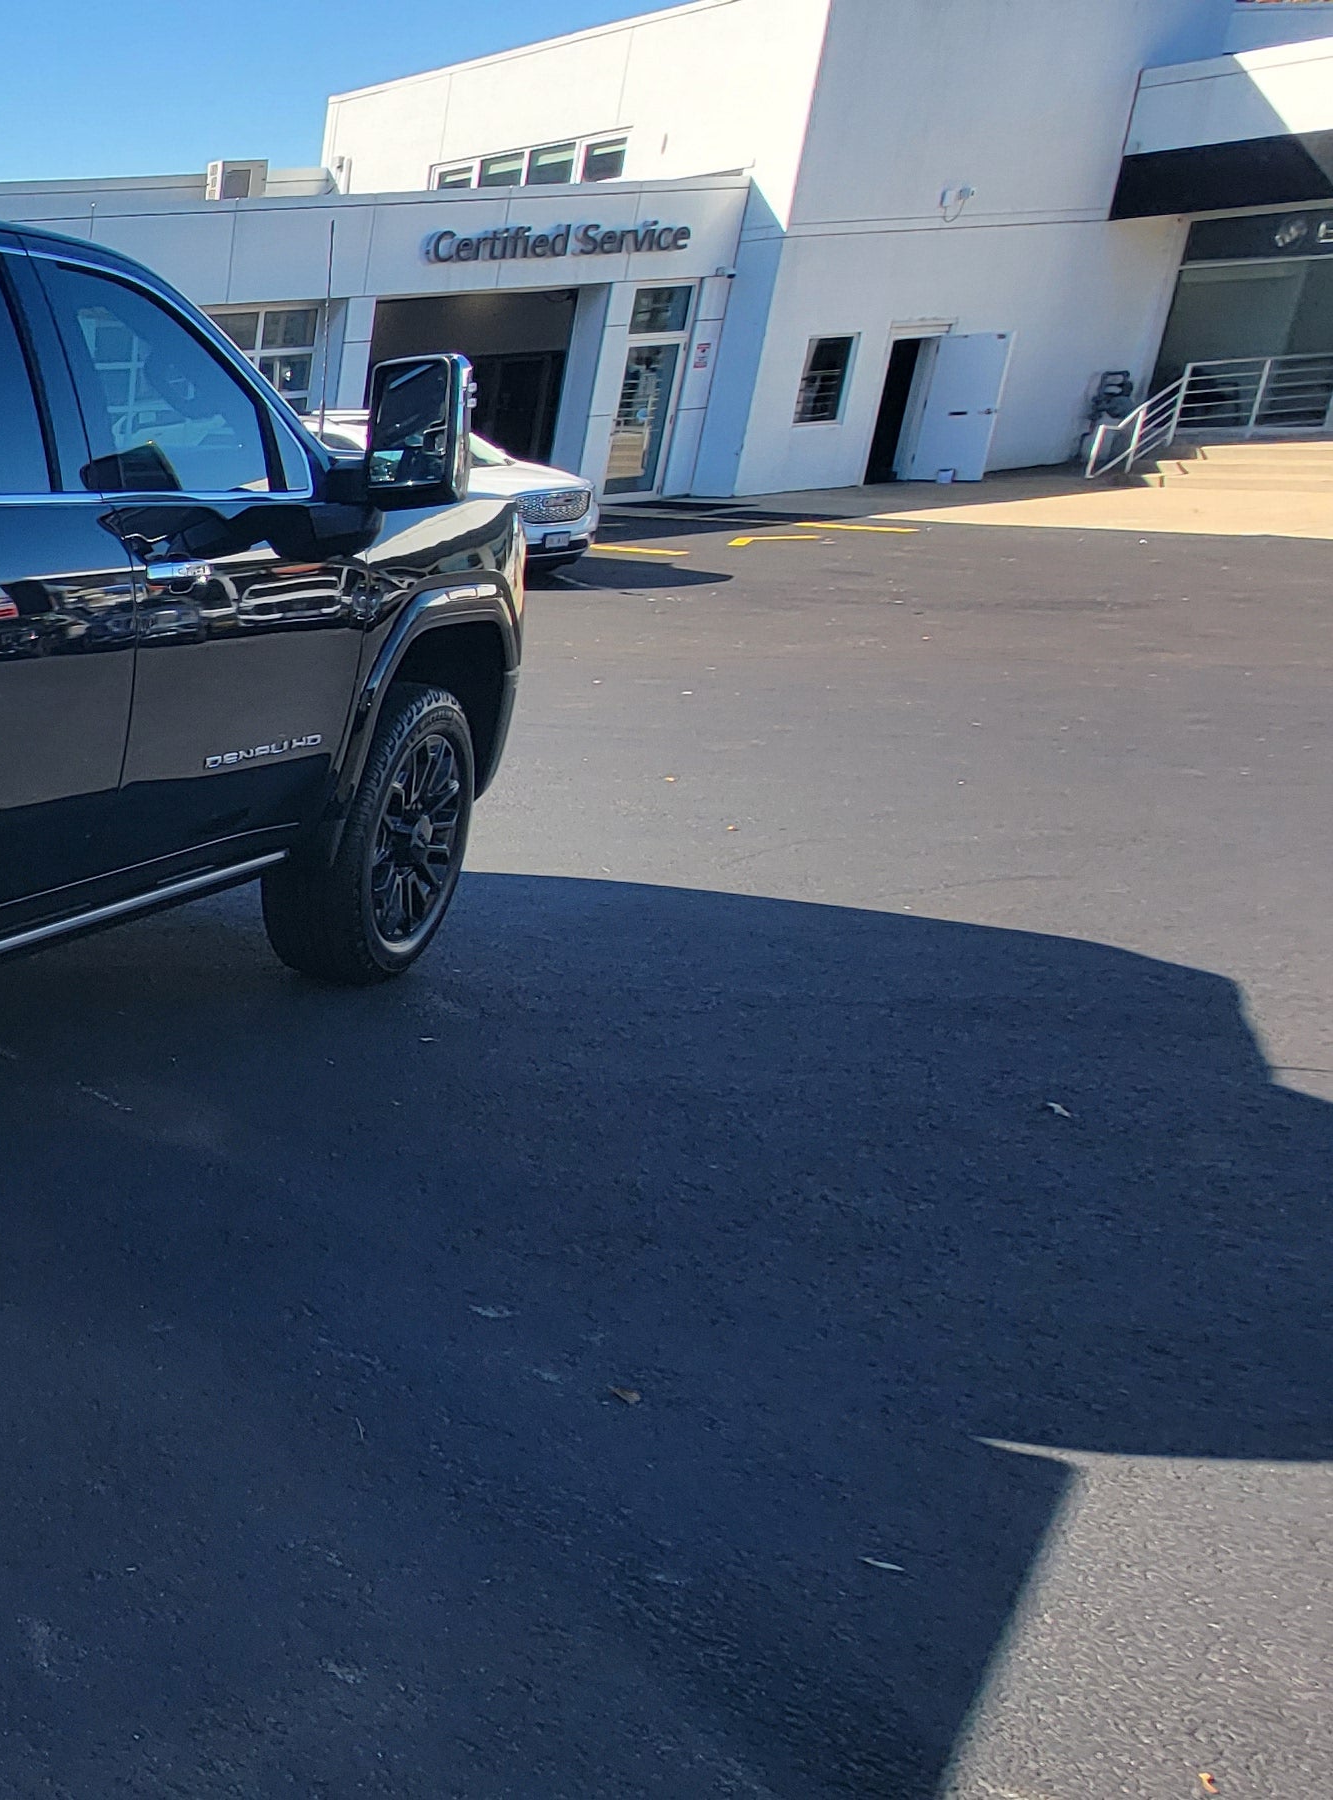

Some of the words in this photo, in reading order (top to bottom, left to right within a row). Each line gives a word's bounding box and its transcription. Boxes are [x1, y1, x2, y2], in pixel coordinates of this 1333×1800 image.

[429, 224, 572, 263] Certified
[578, 220, 691, 255] Service
[205, 740, 288, 769] DENALI
[291, 734, 322, 749] HD
